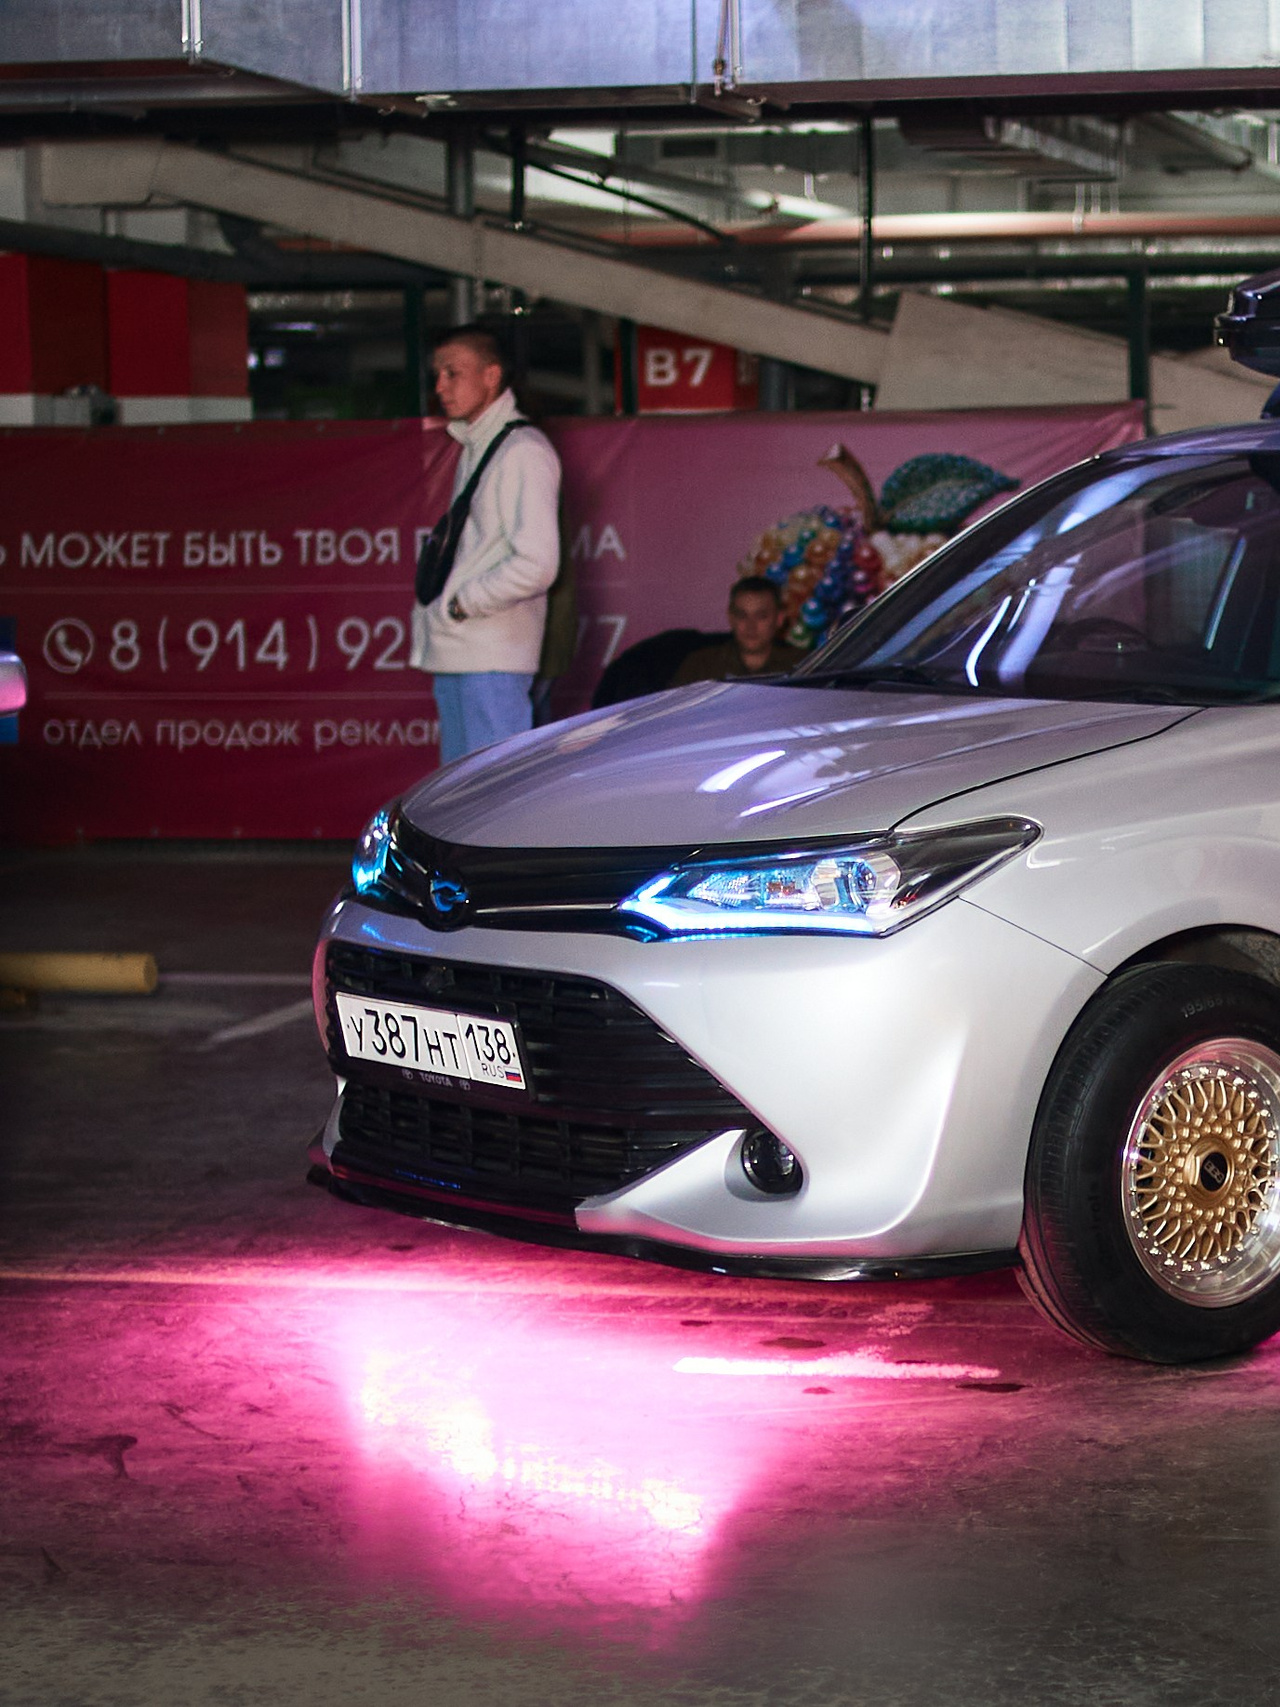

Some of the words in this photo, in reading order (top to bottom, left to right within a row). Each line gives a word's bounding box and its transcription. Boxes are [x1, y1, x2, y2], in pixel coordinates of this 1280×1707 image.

[645, 349, 712, 386] B7
[20, 532, 171, 567] МОЖЕТ
[184, 533, 282, 566] БЫТЬ
[293, 530, 399, 564] ТВОЯ
[43, 717, 142, 748] отдел
[155, 715, 300, 752] продаж
[465, 1023, 511, 1065] 138
[420, 1072, 453, 1087] TOYOTA
[481, 1061, 505, 1080] RUS
